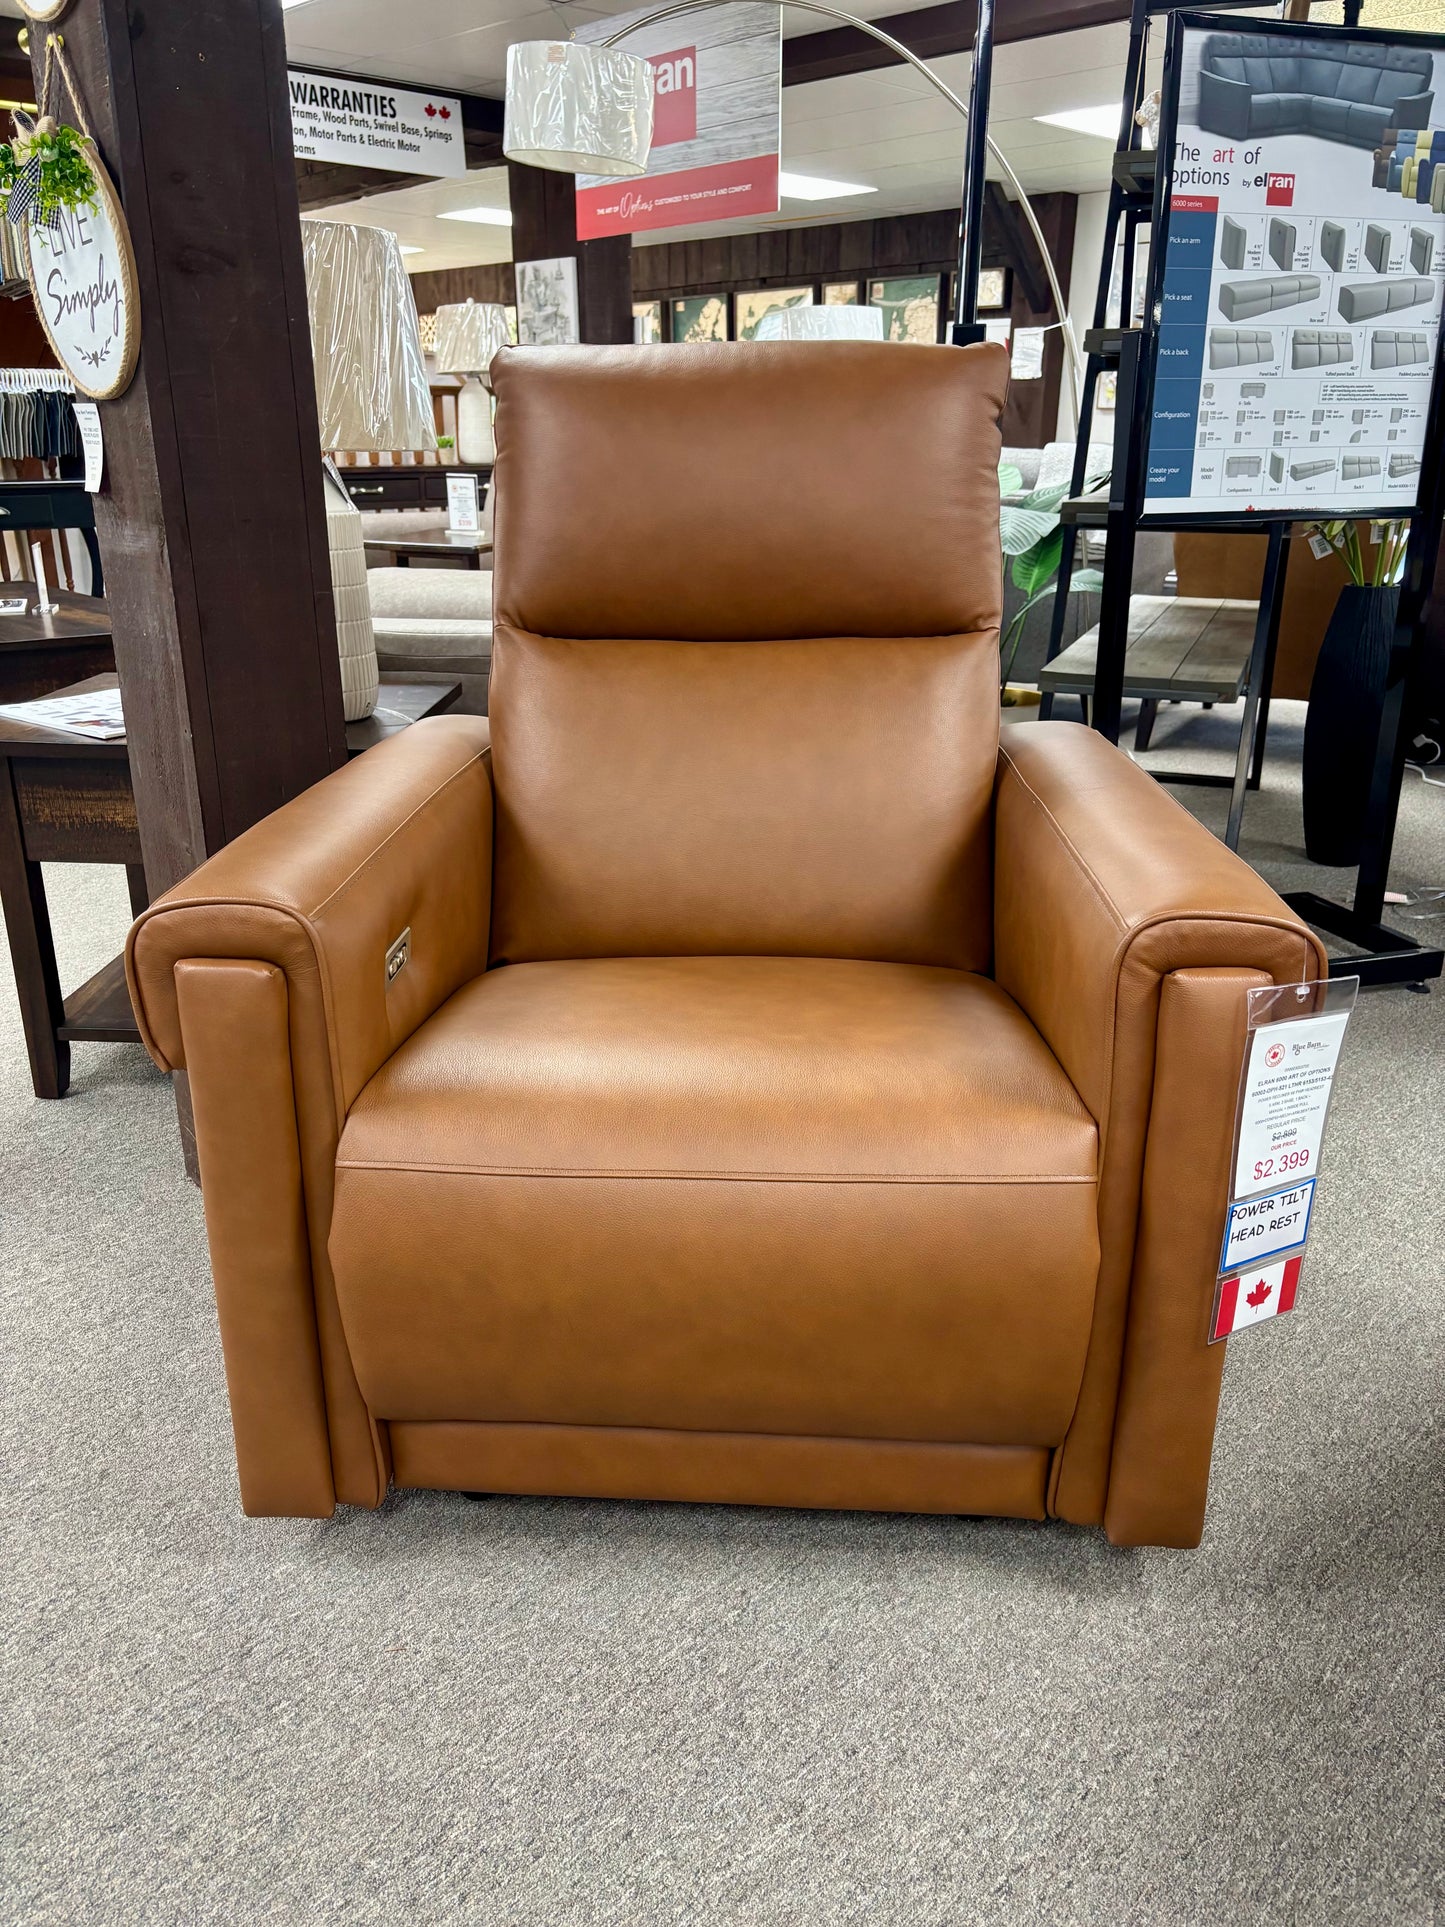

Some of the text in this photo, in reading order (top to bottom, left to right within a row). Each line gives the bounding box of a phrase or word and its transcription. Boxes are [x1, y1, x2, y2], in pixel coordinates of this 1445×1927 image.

[290, 80, 397, 119] WARRANTIES
[292, 106, 452, 143] Frame, Wood Parts, Swivel Base, Springs
[309, 126, 334, 140] Motor
[337, 130, 357, 144] Parts
[359, 134, 365, 144] &
[368, 135, 396, 149] Electric
[398, 140, 421, 153] Motor
[1212, 147, 1235, 163] art
[1244, 146, 1262, 165] of
[1172, 167, 1294, 189] options by elran
[1172, 199, 1186, 207] 6000
[1169, 236, 1181, 244] Pick
[47, 253, 123, 337] Simply
[1164, 293, 1176, 301] Pick
[1159, 348, 1171, 356] Pick
[1176, 348, 1189, 356] back
[1153, 411, 1191, 420] Configuration
[1149, 466, 1180, 475] Create your
[1292, 1043, 1306, 1056] Blue
[1307, 1041, 1322, 1050] Barn
[1257, 1079, 1276, 1087] ELRAN
[1276, 1075, 1288, 1083] 6000
[1288, 1073, 1299, 1081] ART
[1307, 1066, 1331, 1076] OPTIONS
[1266, 1116, 1306, 1130] REGULAR PRICE
[1270, 1139, 1297, 1152] OUR PRICE
[1253, 1149, 1310, 1181] $2.399
[1231, 1188, 1308, 1220] POWER TILT
[1230, 1211, 1301, 1244] HEAD REST
